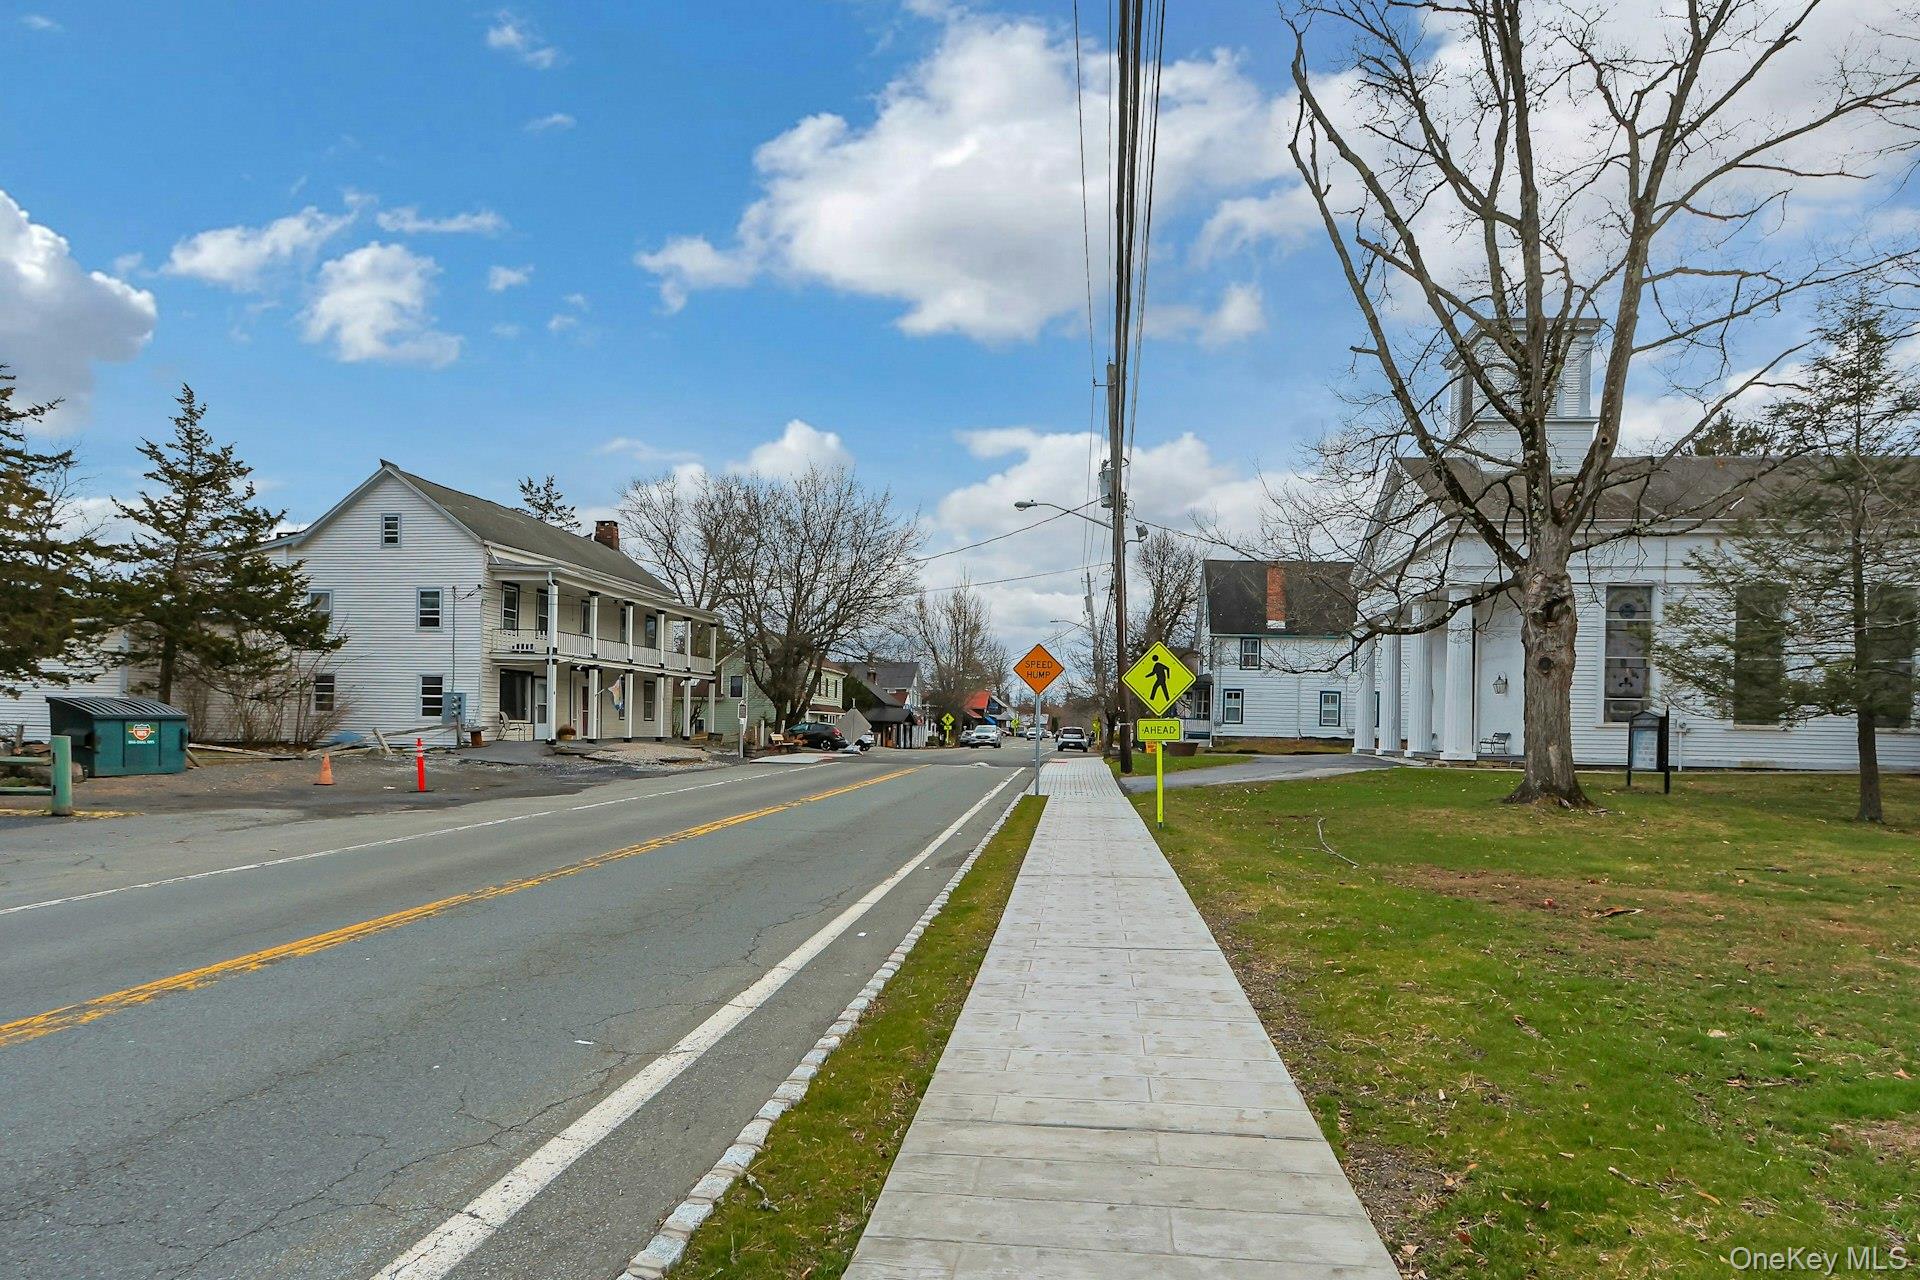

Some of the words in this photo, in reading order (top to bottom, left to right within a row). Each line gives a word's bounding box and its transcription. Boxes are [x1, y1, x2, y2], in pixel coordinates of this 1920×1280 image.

[1025, 661, 1053, 669] SPEED
[1026, 670, 1050, 678] HUMP
[1144, 725, 1174, 735] AHEAD
